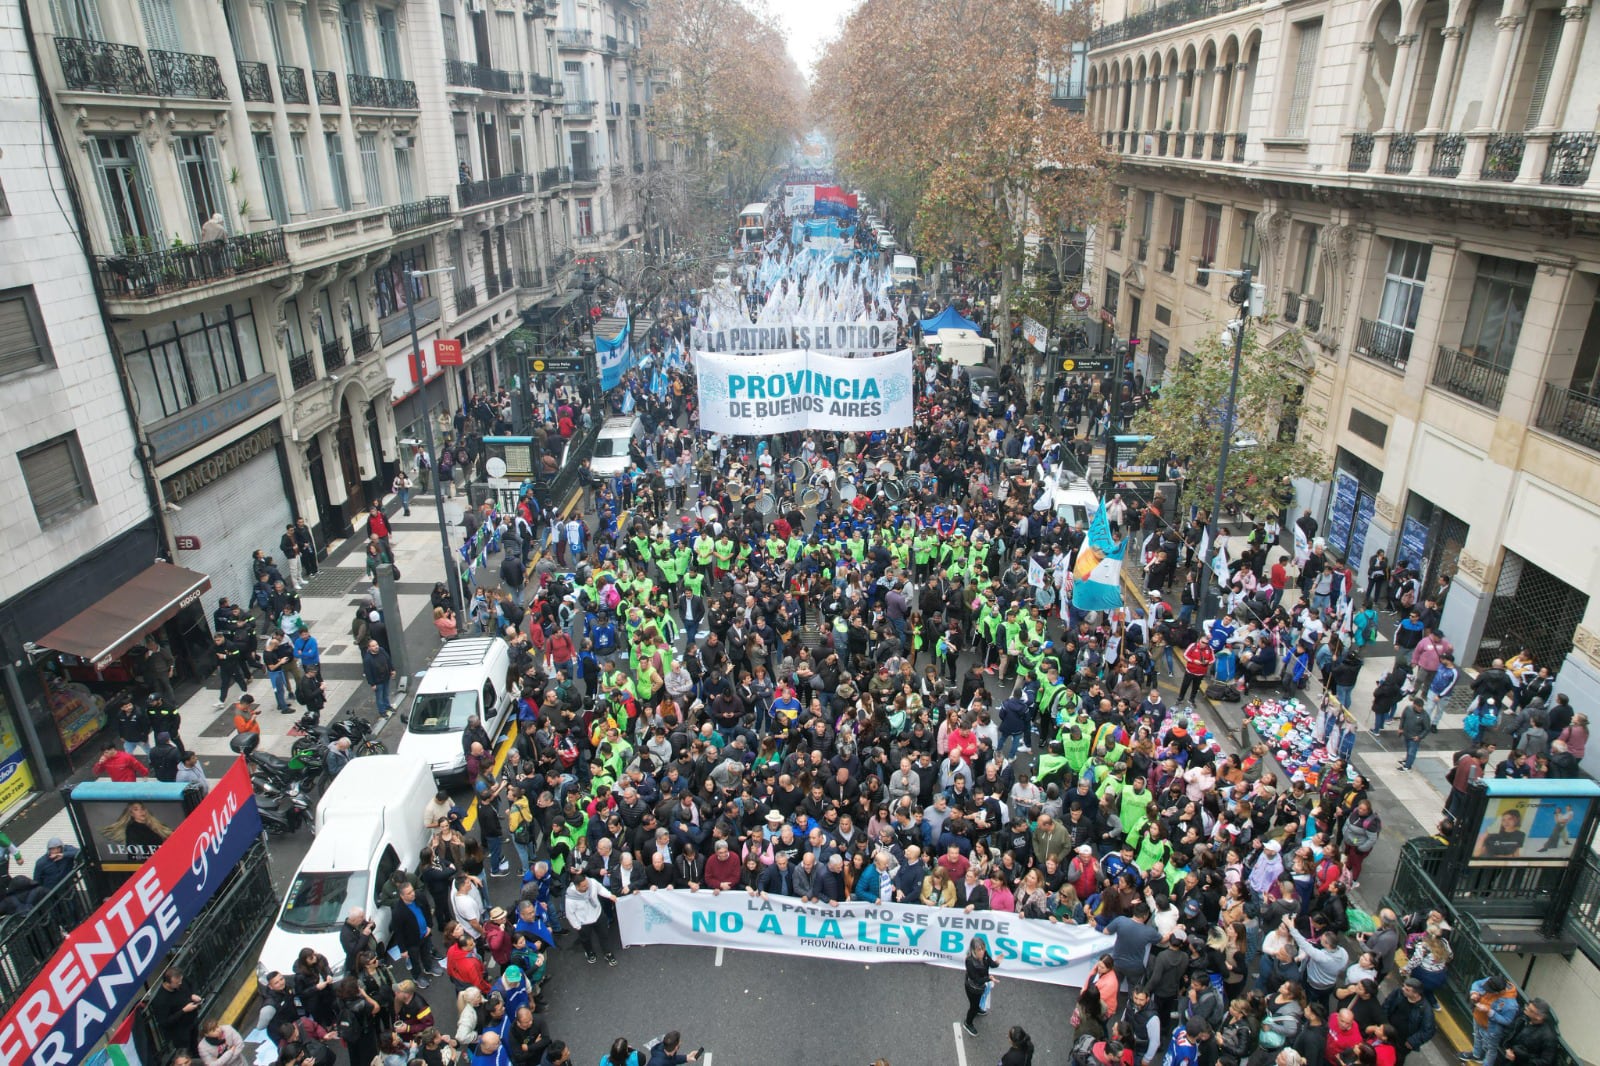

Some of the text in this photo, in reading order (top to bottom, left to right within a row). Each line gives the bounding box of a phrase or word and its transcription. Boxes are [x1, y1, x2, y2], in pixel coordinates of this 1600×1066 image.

[707, 325, 880, 352] LA PATRIA ES EL OTRO
[728, 369, 881, 401] PROVINCIA
[729, 395, 882, 418] DE BUENOS AIRES
[179, 589, 201, 609] KIOSCO
[107, 844, 162, 855] LEOLE
[191, 790, 237, 892] Pilar
[748, 899, 1010, 935] LA PATRIA NO SE VENDE
[692, 910, 1070, 968] NO A LA LEY BASES
[800, 938, 953, 961] PROVINCIA DE BUENOS AIRES
[0, 866, 165, 1066] FRENTE
[31, 894, 181, 1066] RANDE
